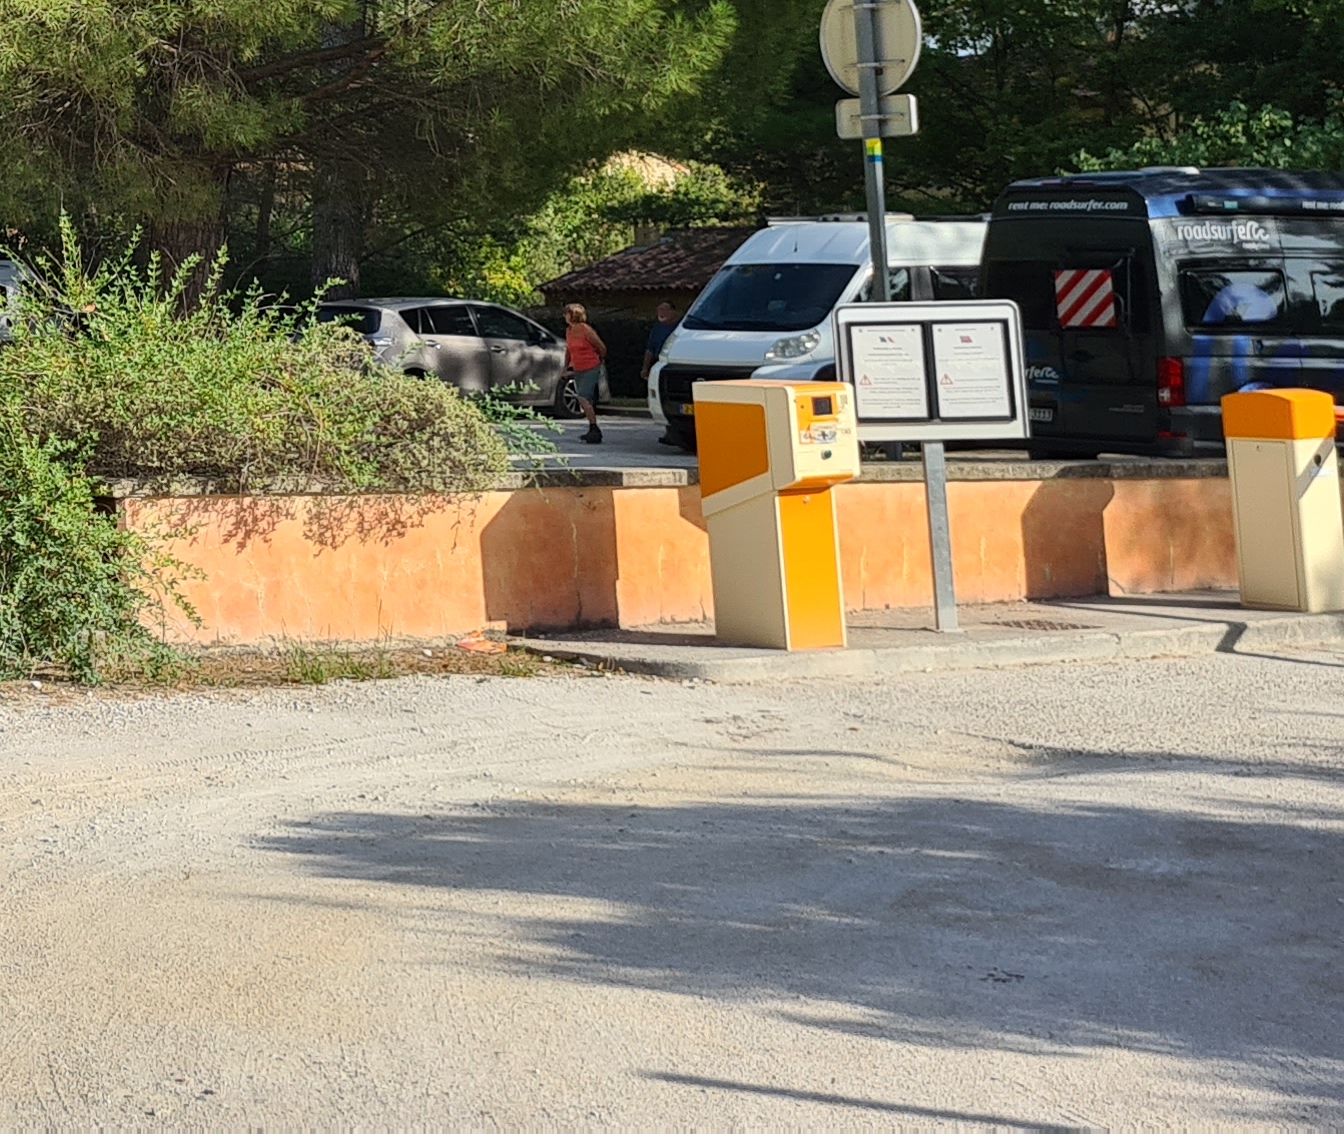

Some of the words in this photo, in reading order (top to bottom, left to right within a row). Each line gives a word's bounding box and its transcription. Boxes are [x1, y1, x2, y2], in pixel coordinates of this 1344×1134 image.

[1008, 201, 1028, 211] rent
[1029, 202, 1048, 211] me:
[1049, 199, 1128, 212] roadsurfer.com
[1177, 220, 1270, 244] roadsurfer
